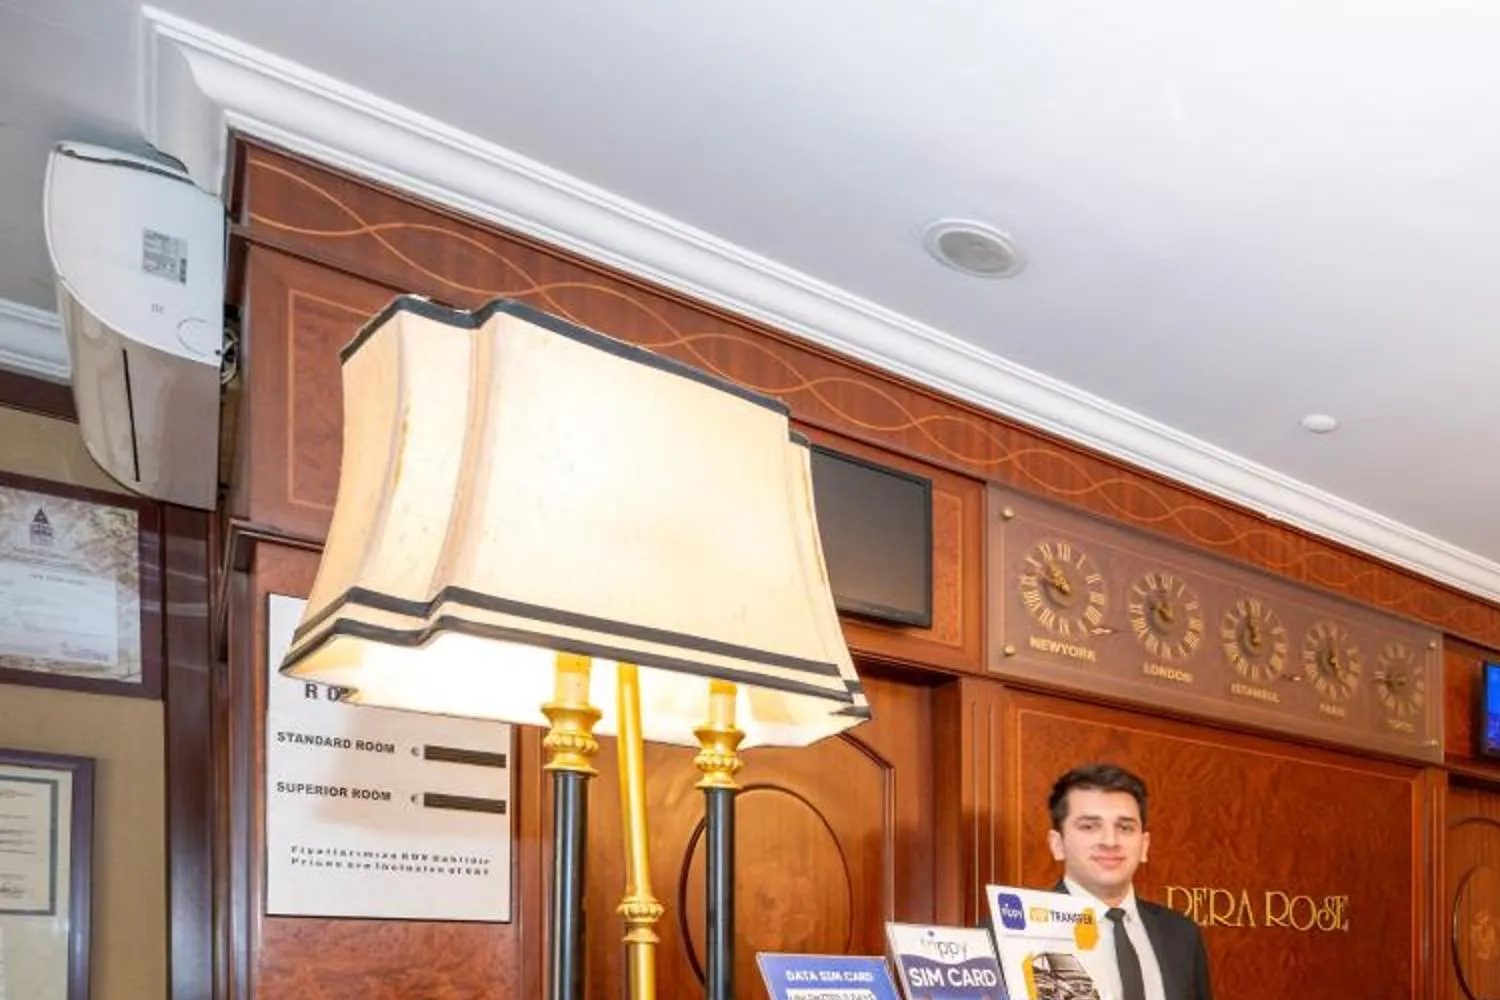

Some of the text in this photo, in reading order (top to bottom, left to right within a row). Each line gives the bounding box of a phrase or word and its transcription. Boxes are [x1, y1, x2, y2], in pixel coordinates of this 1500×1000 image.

[1143, 660, 1194, 684] LONDON
[276, 731, 351, 749] STANDARD
[355, 739, 395, 754] ROOM
[276, 781, 348, 798] SUPERIOR
[351, 788, 392, 802] ROOM
[1161, 885, 1350, 932] PERA ROSE
[785, 970, 818, 982] DATA
[908, 967, 997, 988] SIM CARD
